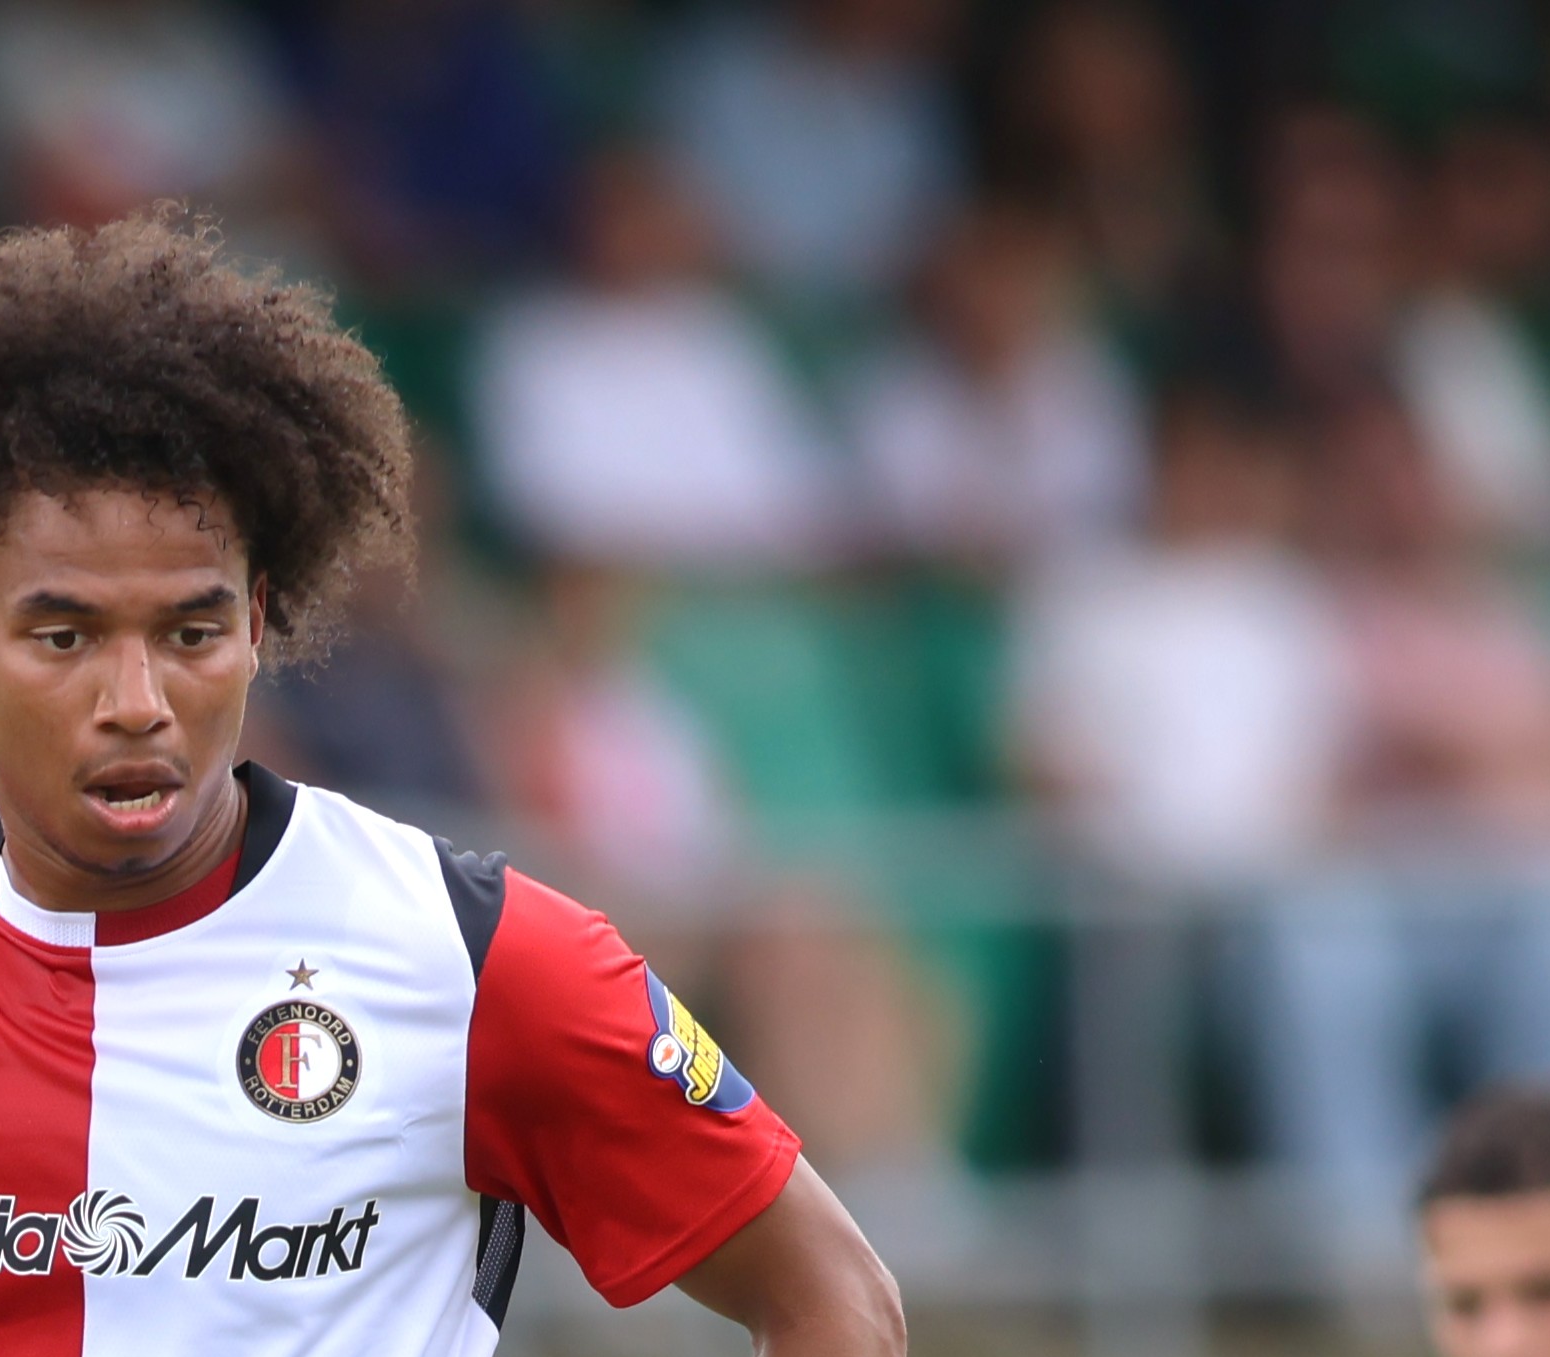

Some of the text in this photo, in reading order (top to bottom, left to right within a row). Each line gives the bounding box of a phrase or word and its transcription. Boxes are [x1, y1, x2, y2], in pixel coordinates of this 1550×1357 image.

[246, 1004, 353, 1046] FEYENOORD
[275, 1032, 323, 1089] F
[244, 1075, 354, 1118] ROTTERDAM
